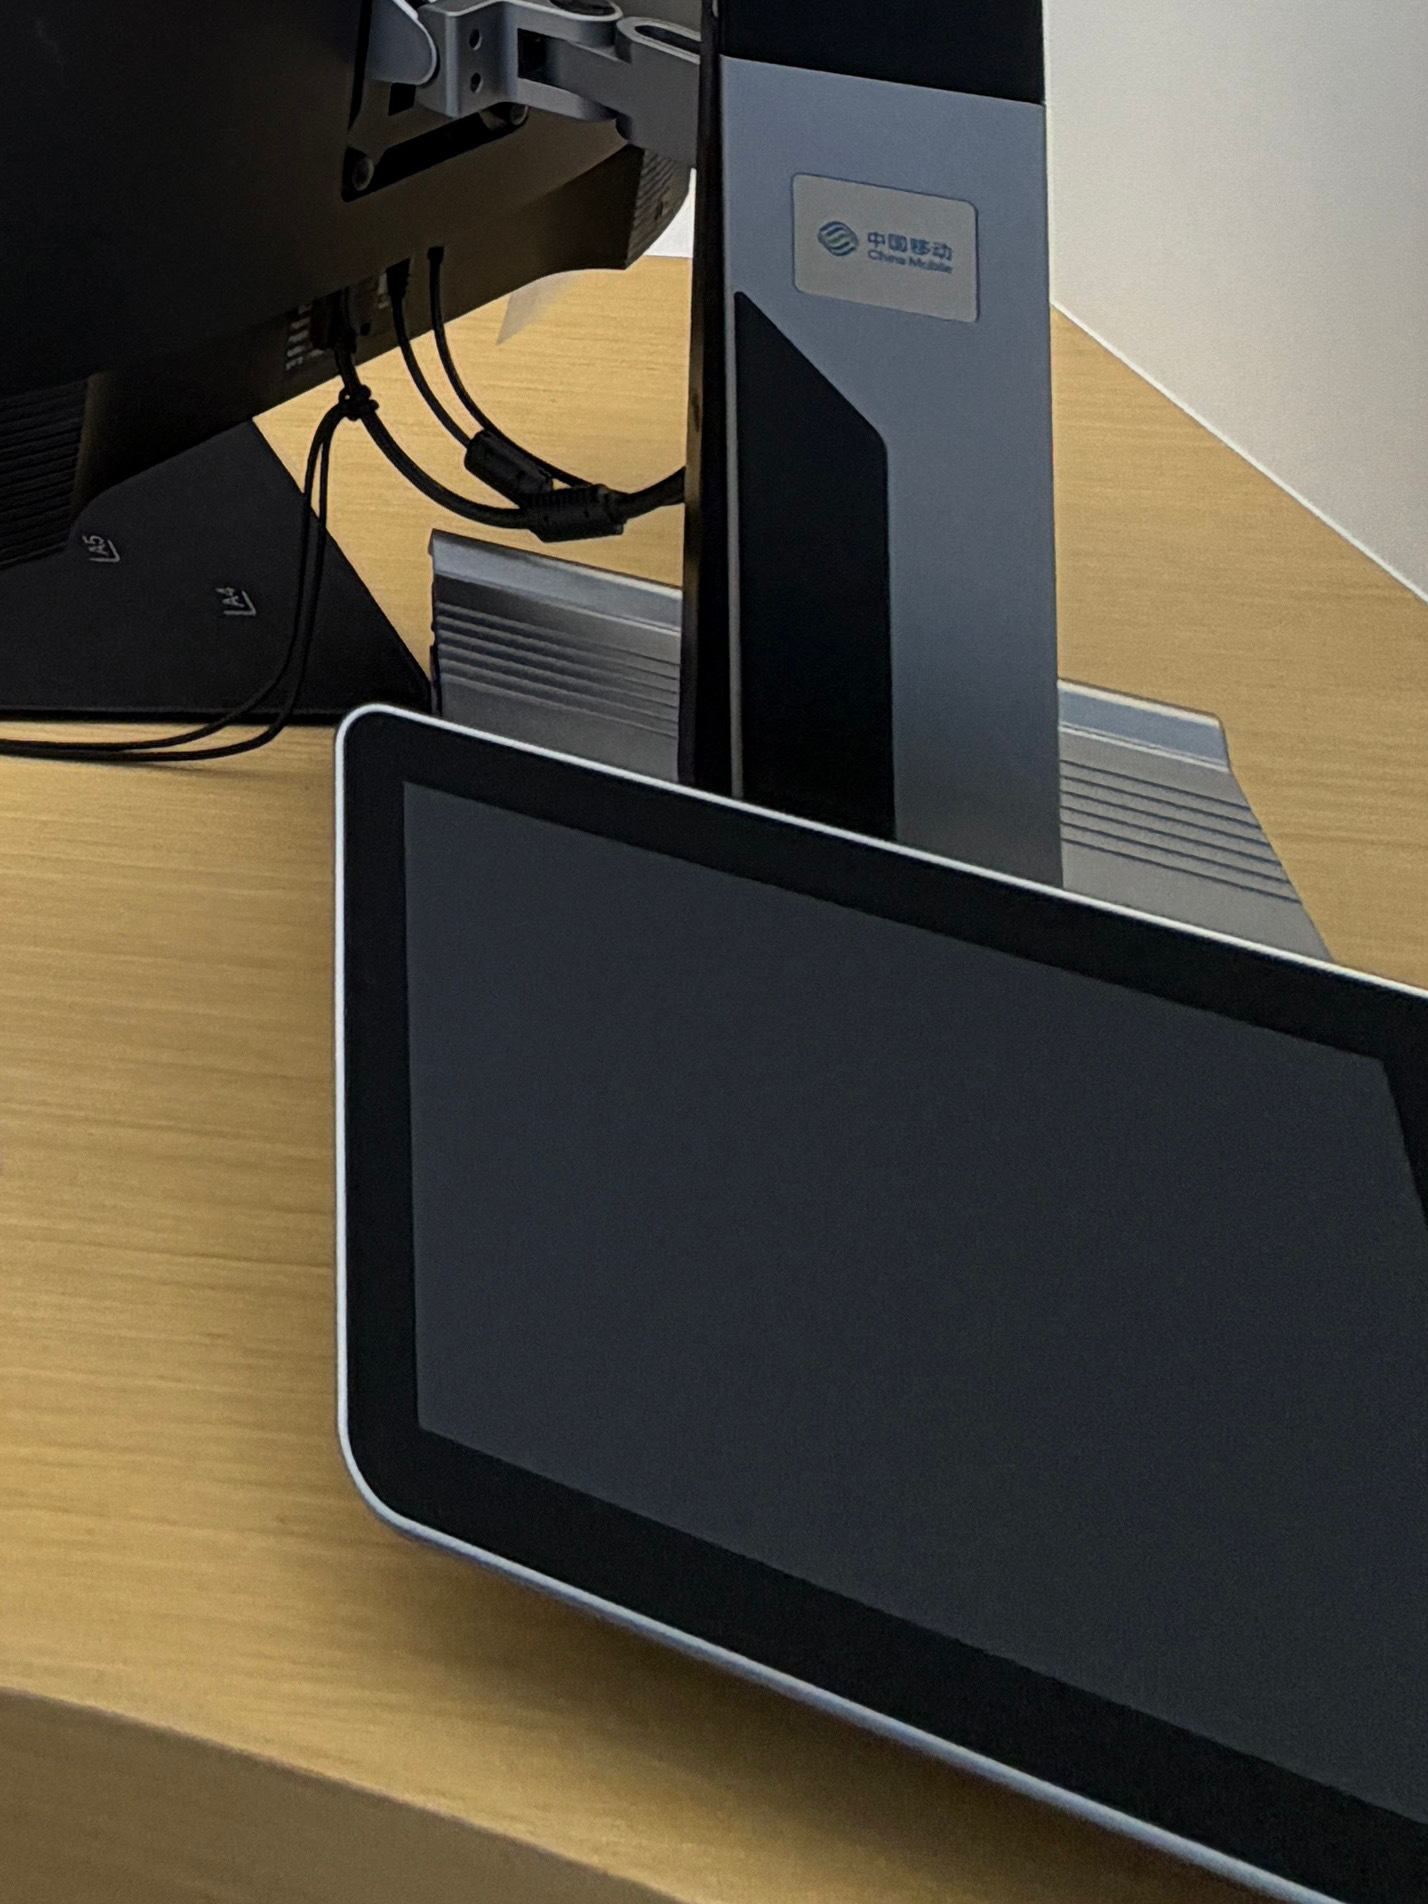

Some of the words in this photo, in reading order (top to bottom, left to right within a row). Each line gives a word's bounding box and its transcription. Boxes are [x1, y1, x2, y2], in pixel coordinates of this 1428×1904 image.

[868, 232, 952, 261] 中国移动
[868, 250, 906, 265] China
[909, 257, 953, 274] Mobile
